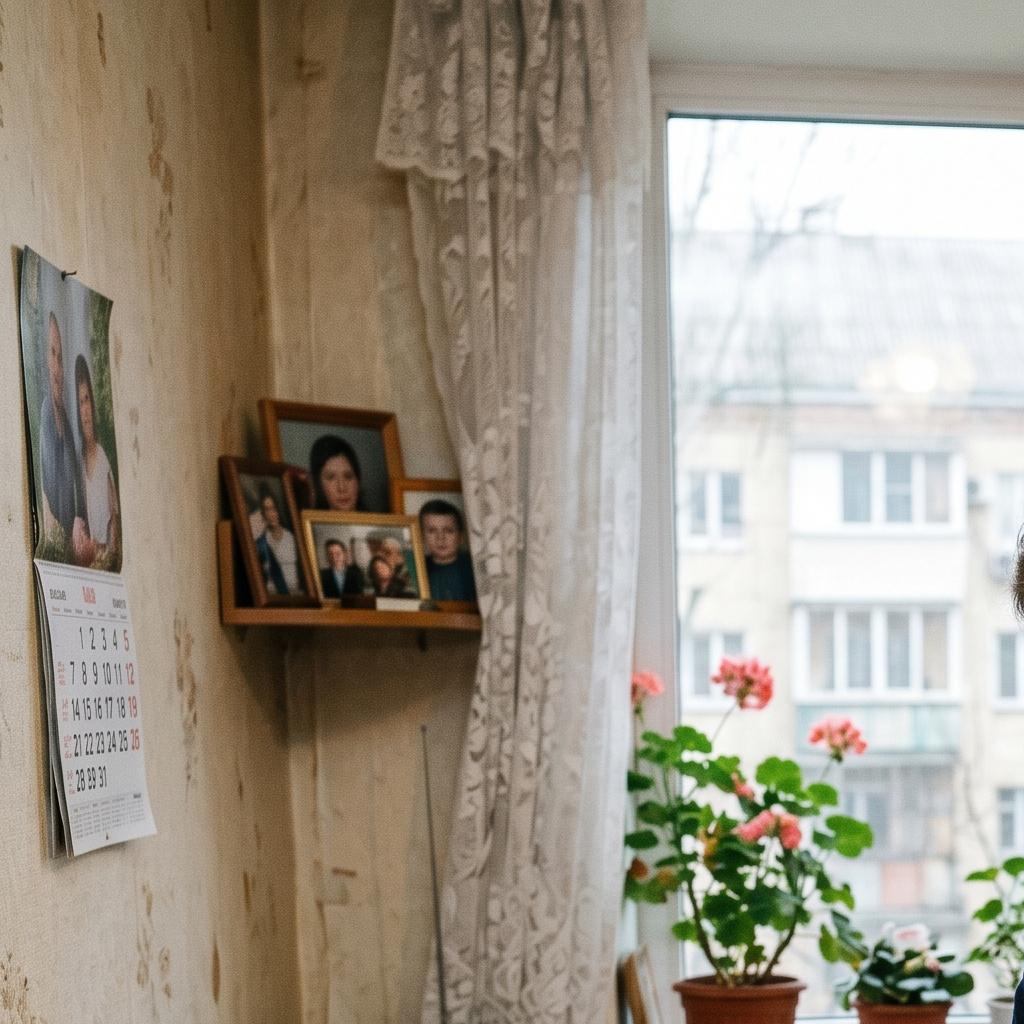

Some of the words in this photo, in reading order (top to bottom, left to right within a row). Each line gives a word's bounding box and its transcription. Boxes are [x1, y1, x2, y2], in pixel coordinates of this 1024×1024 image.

[79, 627, 84, 650] 1
[89, 626, 96, 650] 2
[101, 627, 107, 651] 3
[112, 629, 118, 651] 4
[123, 629, 130, 652] 5
[70, 661, 75, 685] 7
[81, 661, 88, 686] 8
[92, 661, 98, 685] 9
[102, 662, 112, 685] 10
[114, 662, 123, 685] 11
[125, 662, 135, 686] 12
[71, 697, 81, 721] 14
[82, 697, 92, 721] 15
[93, 696, 103, 720] 16
[105, 696, 113, 719] 17
[116, 696, 126, 719] 18
[127, 695, 138, 718] 19
[73, 733, 82, 758] 21
[84, 732, 94, 756] 22
[106, 730, 117, 754] 24
[75, 768, 86, 792] 28
[98, 765, 108, 788] 31
